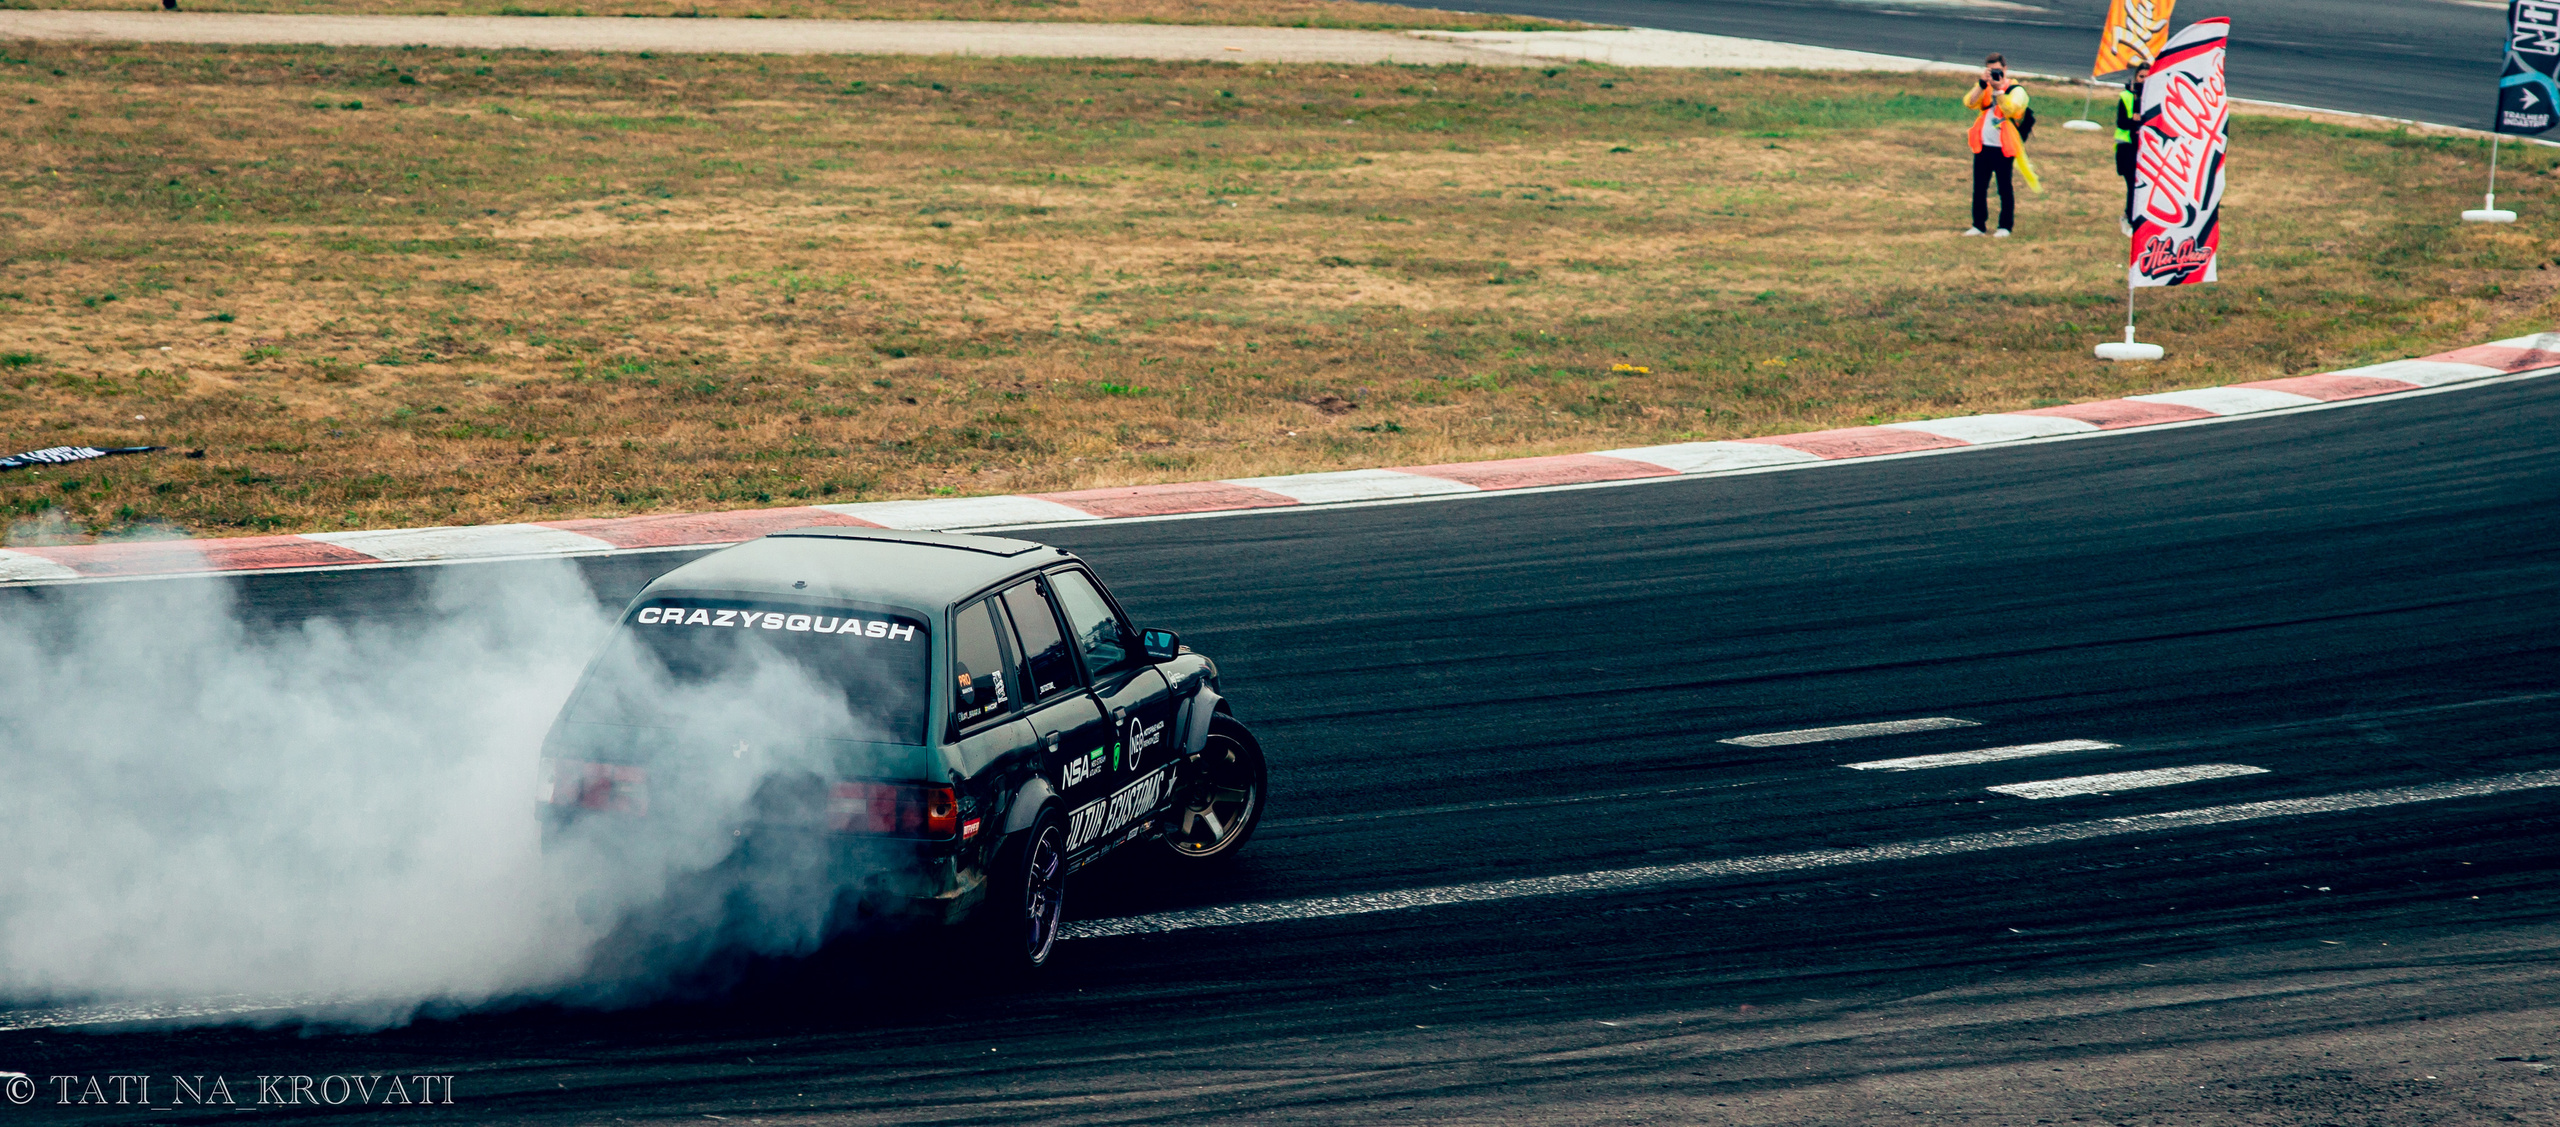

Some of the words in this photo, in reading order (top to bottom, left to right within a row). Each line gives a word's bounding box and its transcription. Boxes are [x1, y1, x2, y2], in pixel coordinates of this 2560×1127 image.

[637, 606, 916, 642] CRAZYSQUASH
[958, 672, 971, 688] PRO
[1062, 754, 1090, 790] NSA
